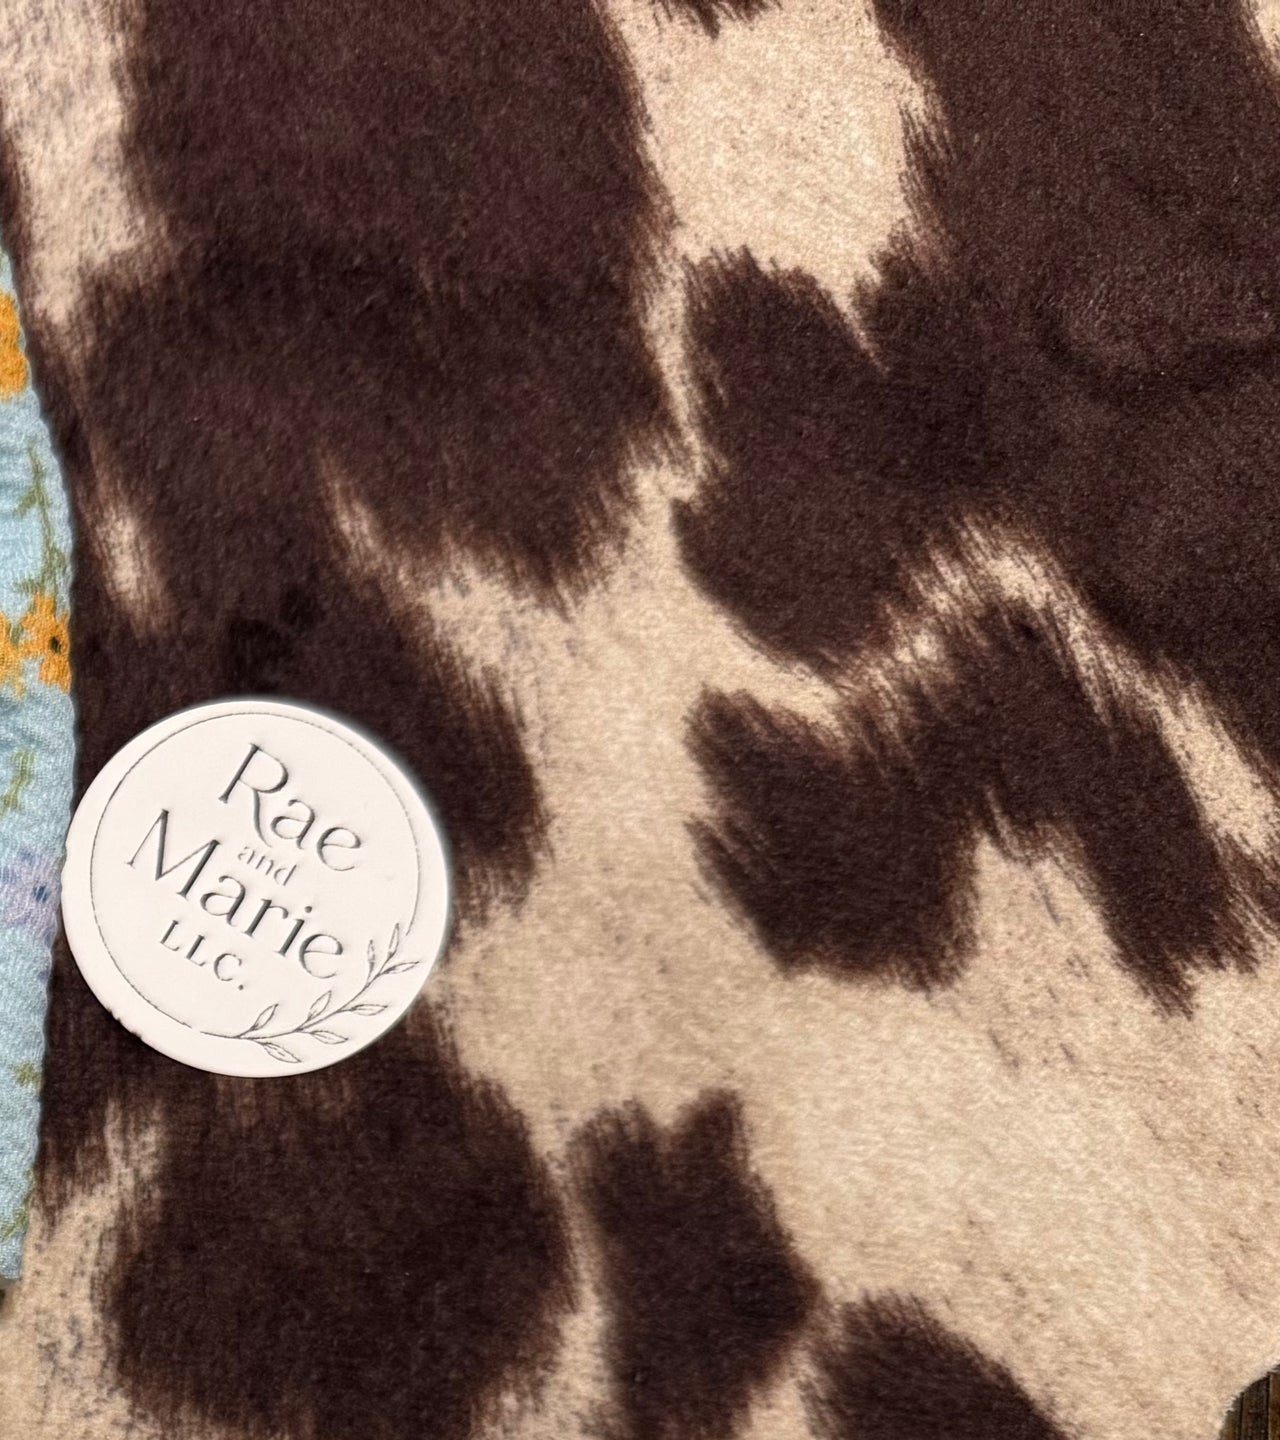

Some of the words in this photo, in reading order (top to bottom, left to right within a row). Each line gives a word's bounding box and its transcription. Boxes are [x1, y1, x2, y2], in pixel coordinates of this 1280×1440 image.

[218, 743, 361, 871] Rae
[126, 809, 343, 979] Marie
[237, 845, 298, 886] and
[159, 920, 244, 991] LLC.
